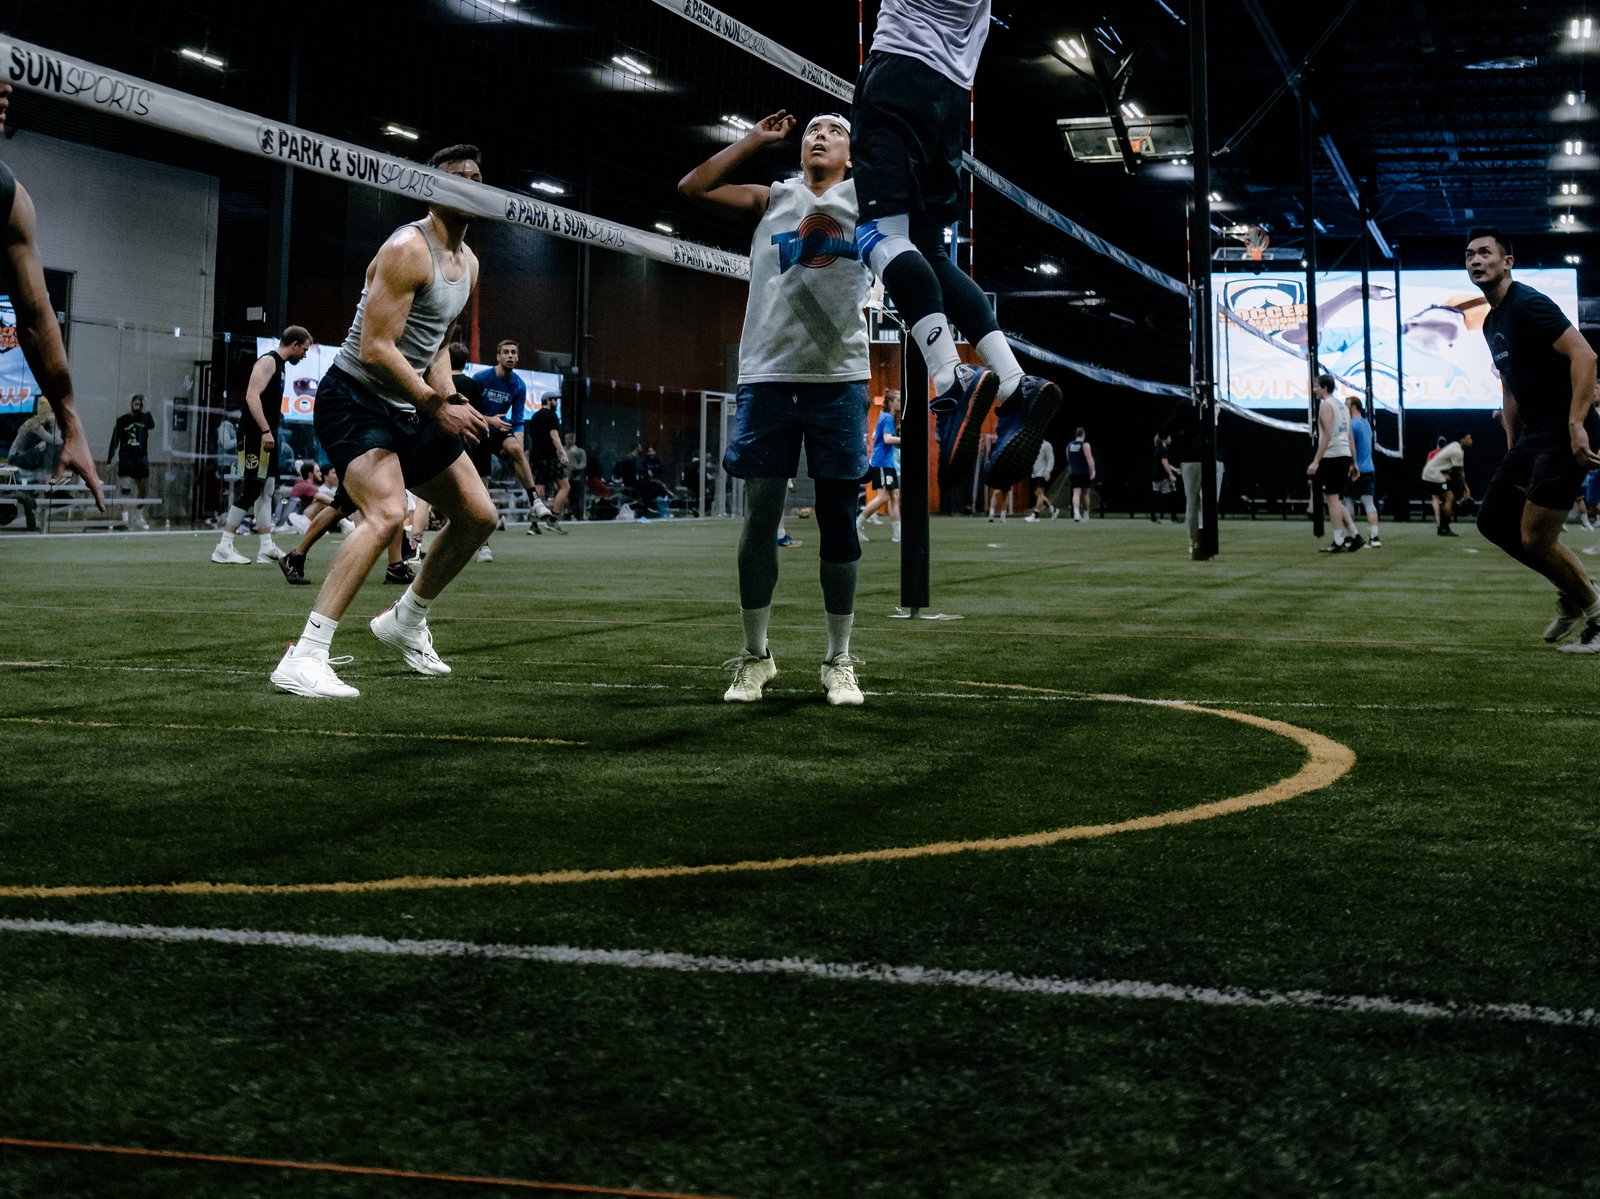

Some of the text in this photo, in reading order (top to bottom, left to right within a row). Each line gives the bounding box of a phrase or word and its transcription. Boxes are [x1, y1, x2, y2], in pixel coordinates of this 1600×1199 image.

[278, 128, 324, 168] PARK
[329, 144, 341, 172] &
[518, 199, 549, 229] PARK
[552, 209, 561, 232] &
